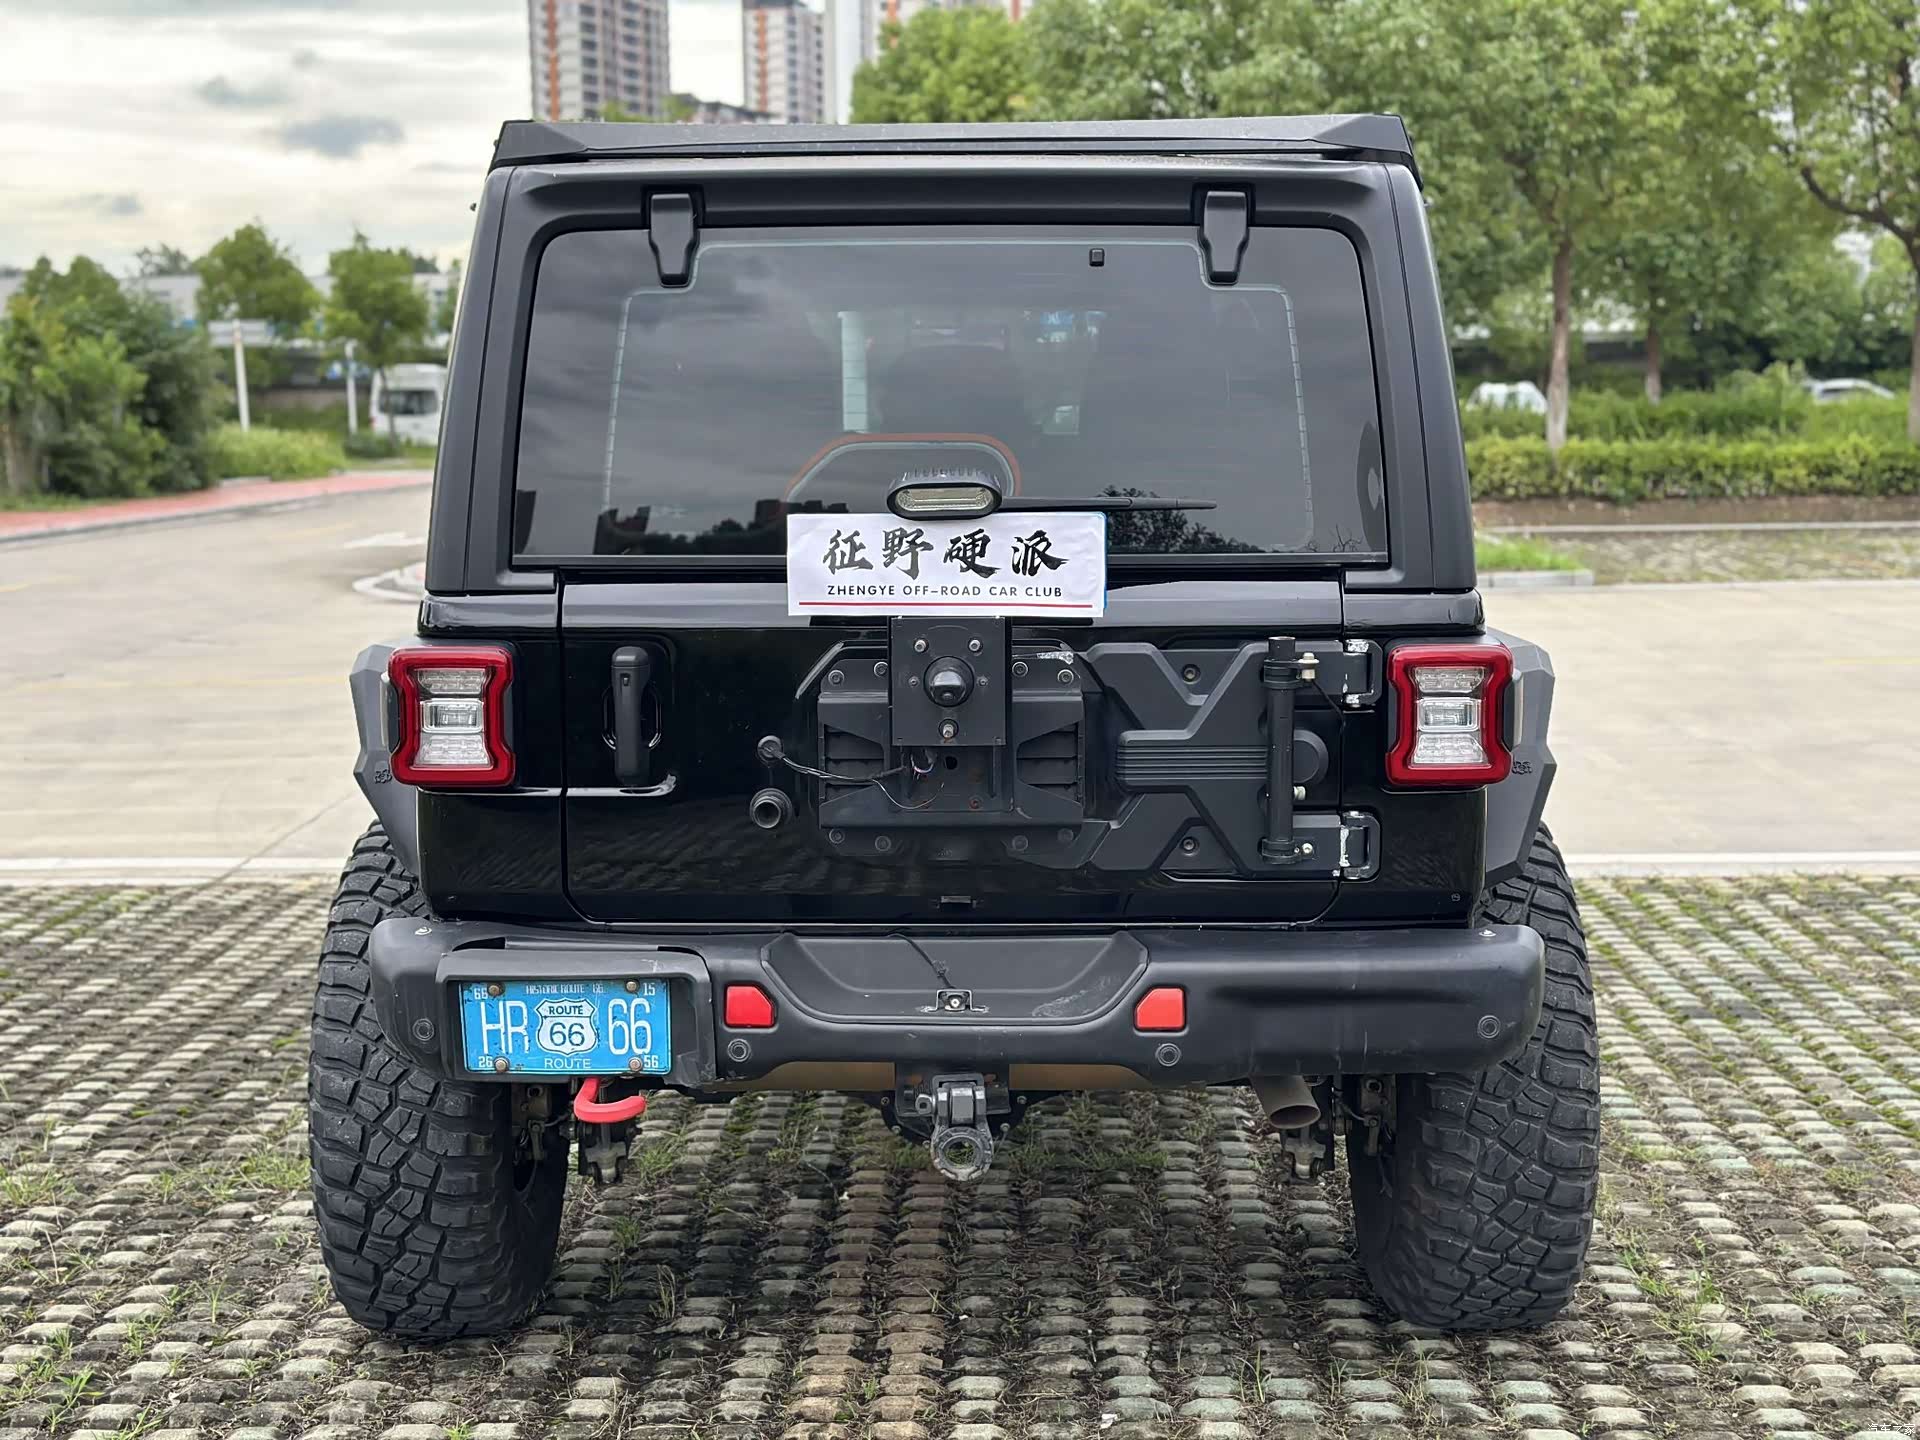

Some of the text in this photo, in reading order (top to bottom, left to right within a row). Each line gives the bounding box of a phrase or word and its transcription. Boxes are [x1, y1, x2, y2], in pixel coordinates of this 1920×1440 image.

[822, 527, 1071, 580] 征野硬派
[827, 584, 1063, 598] ZHENGYE OFF-ROAD CAR CLUB
[560, 983, 586, 994] ROUTE
[548, 1004, 584, 1016] ROUTE
[480, 998, 652, 1056] HR 66
[549, 1021, 585, 1047] 66
[478, 1055, 493, 1068] 26
[544, 1057, 591, 1069] ROUTE
[643, 1055, 659, 1068] 56
